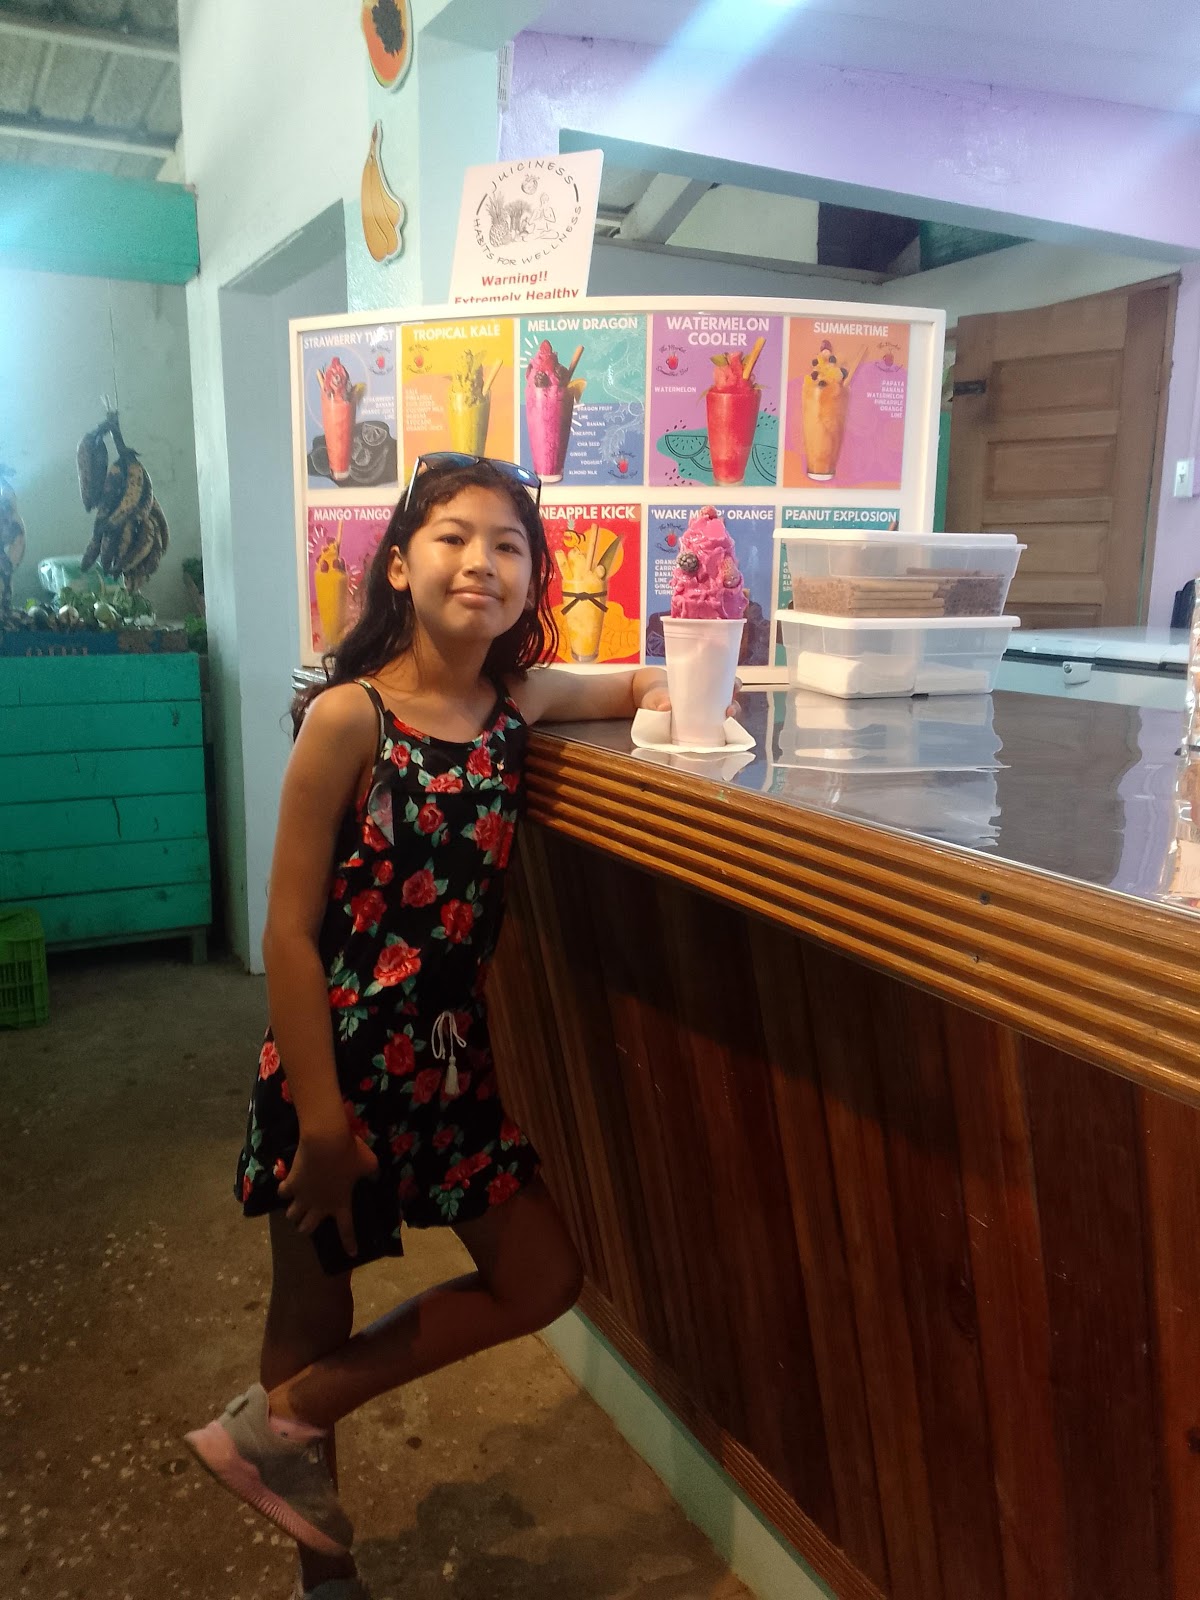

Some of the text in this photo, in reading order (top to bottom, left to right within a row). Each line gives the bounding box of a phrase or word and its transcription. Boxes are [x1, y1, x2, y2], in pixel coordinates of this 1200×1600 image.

[492, 160, 574, 193] JUICINESS
[474, 206, 582, 266] HABITS FOR WELLNESS
[481, 271, 548, 287] Warning!!
[526, 287, 579, 301] Healthy
[527, 317, 638, 332] MELLOW DRAGON
[666, 316, 770, 331] WATERMELON
[813, 322, 889, 337] SUMMERTIME
[304, 329, 394, 349] STRAWBERRY TWST
[413, 323, 500, 341] TROPICAL KALE
[688, 332, 748, 346] COOLER
[313, 508, 392, 520] MANGO TANGO
[539, 505, 636, 520] NEAPPLE KICK
[651, 509, 687, 520] 'WAKE
[689, 509, 699, 519] M
[727, 509, 774, 520] ORANGE
[785, 509, 897, 523] PEANUT EXPLOSION
